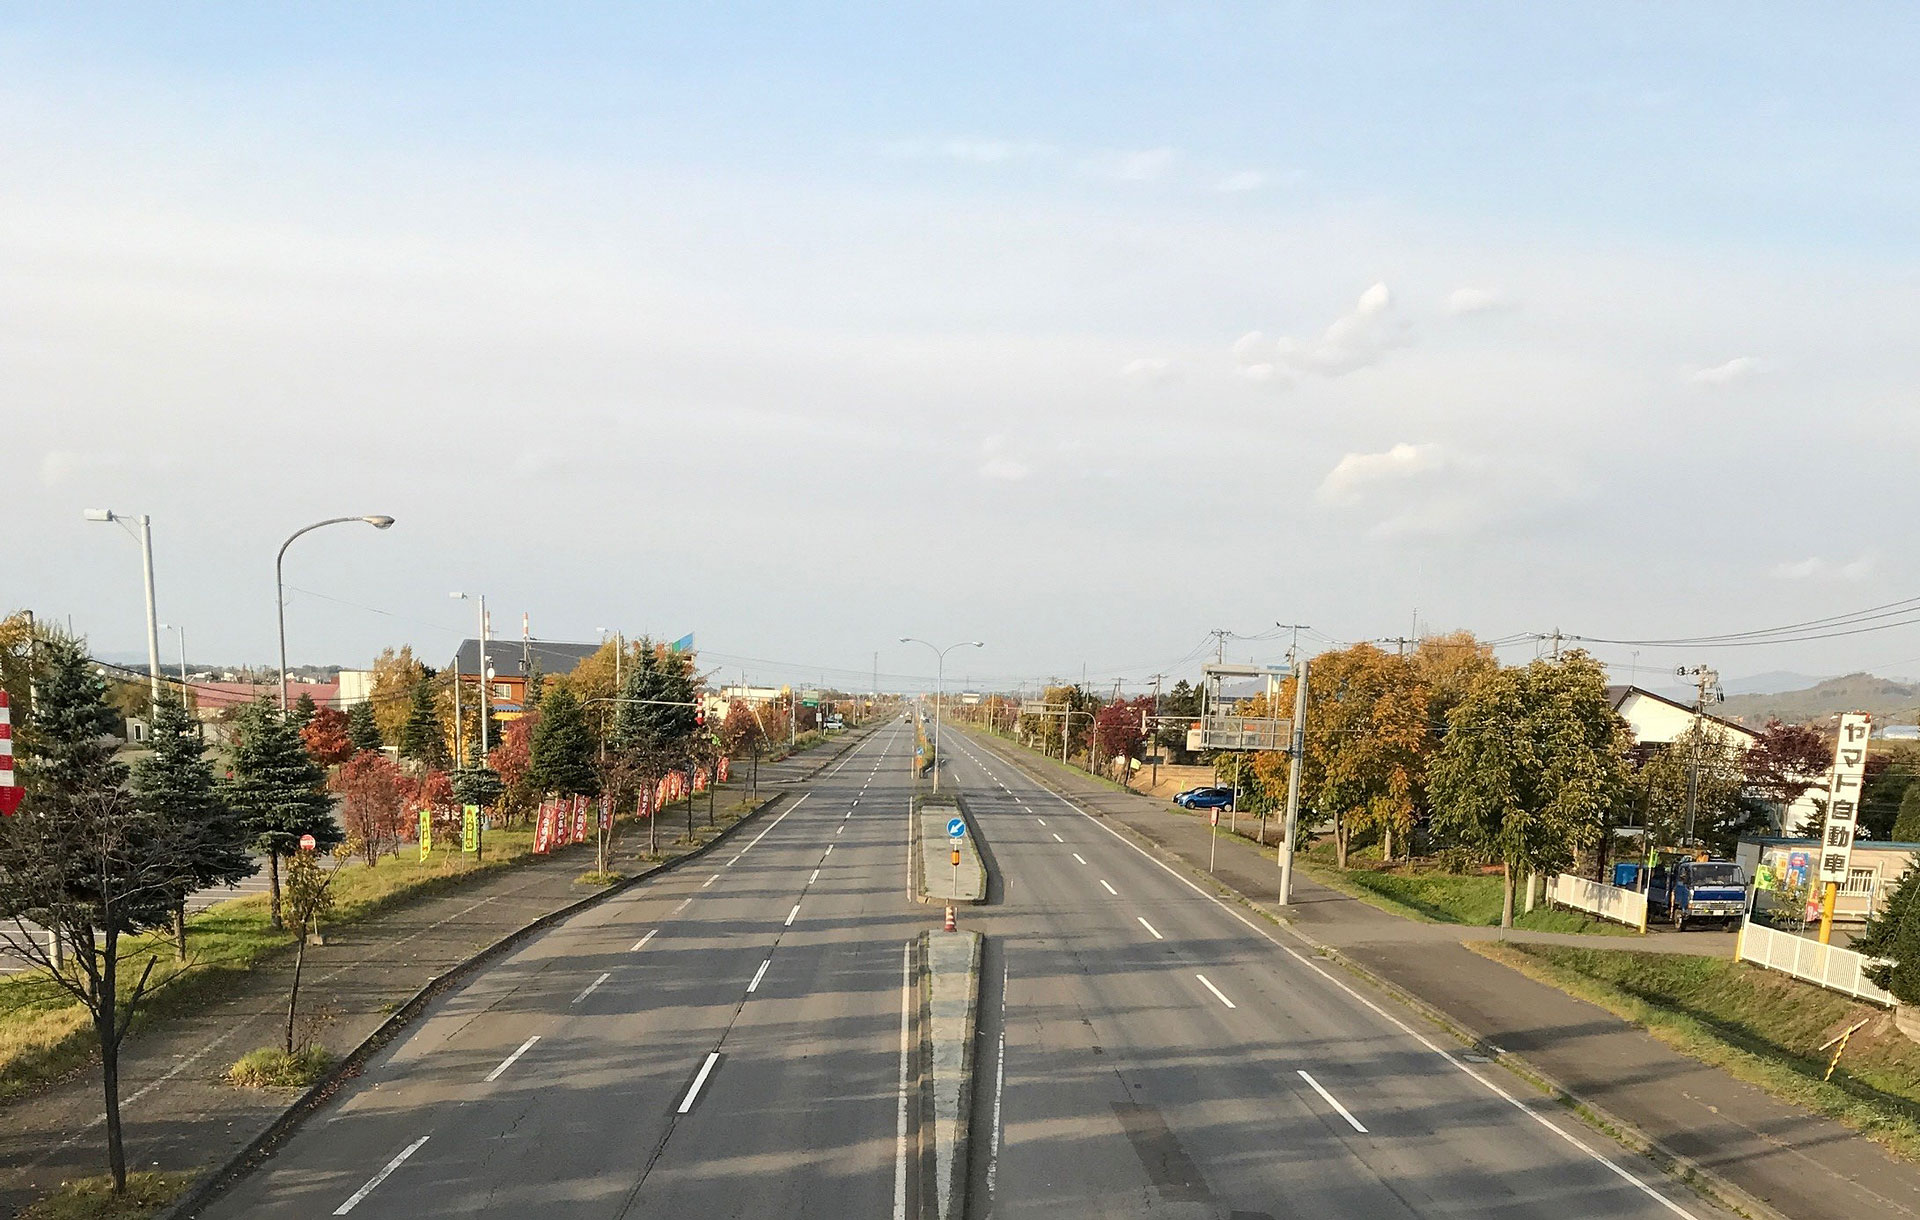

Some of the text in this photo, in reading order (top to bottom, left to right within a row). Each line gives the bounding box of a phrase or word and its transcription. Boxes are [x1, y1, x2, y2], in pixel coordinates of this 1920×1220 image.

[1823, 722, 1866, 874] ヤマト自動車
